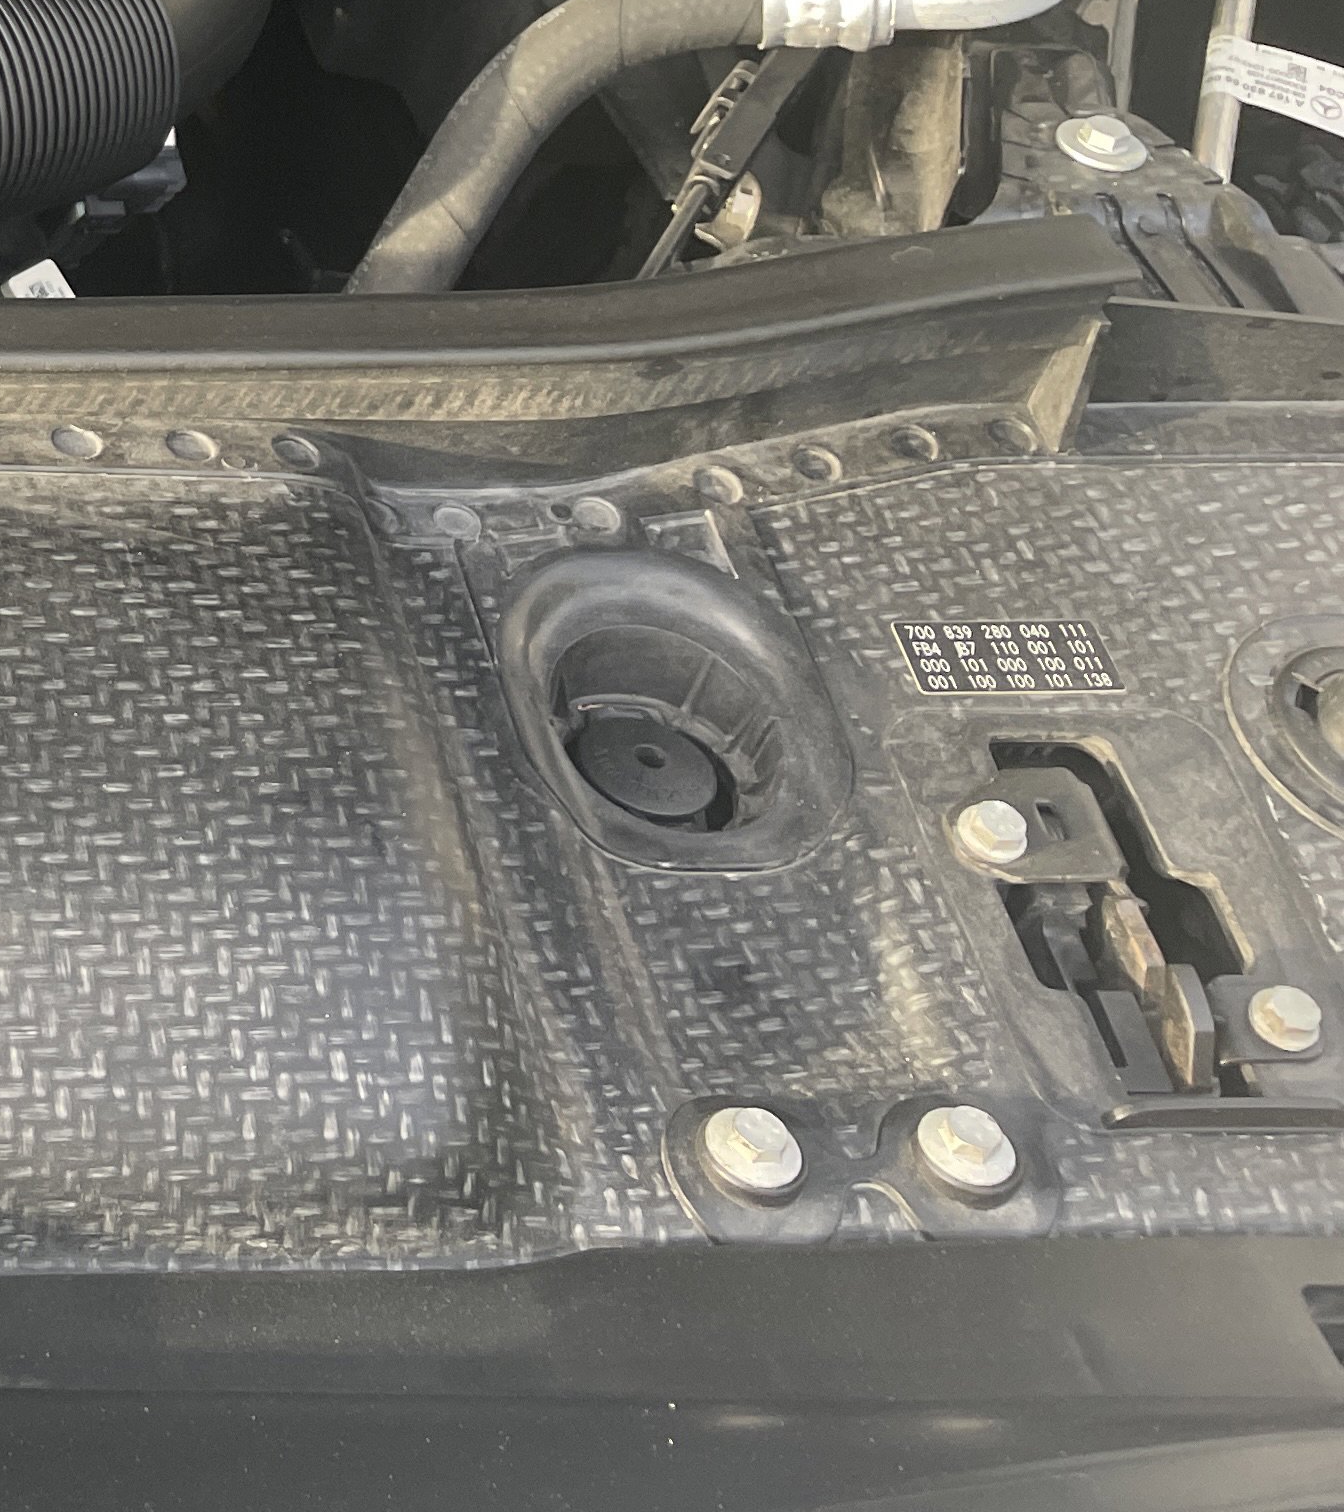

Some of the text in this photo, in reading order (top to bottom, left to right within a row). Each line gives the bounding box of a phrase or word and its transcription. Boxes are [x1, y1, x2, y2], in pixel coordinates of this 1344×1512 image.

[904, 624, 1087, 640] 700 839 280 040 111
[912, 642, 942, 656] FB4
[991, 641, 1019, 655] 110
[1027, 641, 1057, 655] 001
[1067, 641, 1095, 654] 101
[920, 657, 1103, 673] 000 101 000 100 011
[928, 675, 958, 690] 001
[968, 674, 996, 689] 100
[1006, 674, 1035, 689] 100
[1045, 674, 1073, 688] 101
